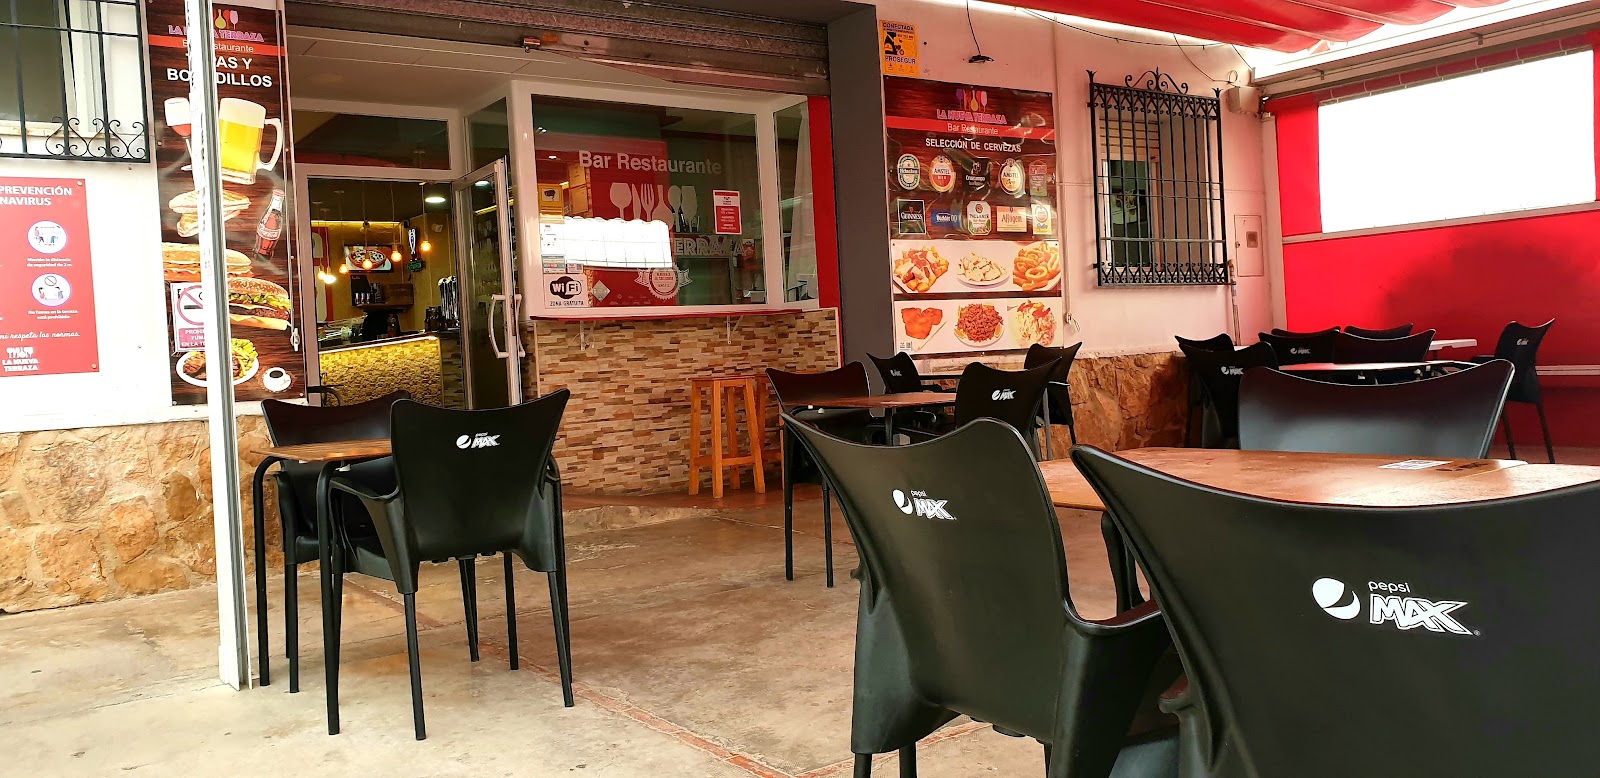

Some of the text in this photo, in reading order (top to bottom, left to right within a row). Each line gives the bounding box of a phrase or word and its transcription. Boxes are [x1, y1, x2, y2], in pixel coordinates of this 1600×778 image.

[168, 24, 183, 36] LA
[214, 42, 254, 53] staurante
[885, 56, 916, 64] PROSEGUR
[167, 68, 273, 87] BODILLOS
[936, 109, 947, 120] LA
[947, 123, 999, 135] Bar Restaurante
[925, 138, 1021, 152] SELECCIÓN DE CERVEZAS
[579, 150, 722, 175] Bar Restaurante
[471, 434, 501, 449] MAX
[913, 498, 956, 520] MAX
[1368, 580, 1411, 594] pepsi
[1370, 594, 1474, 636] MAX
